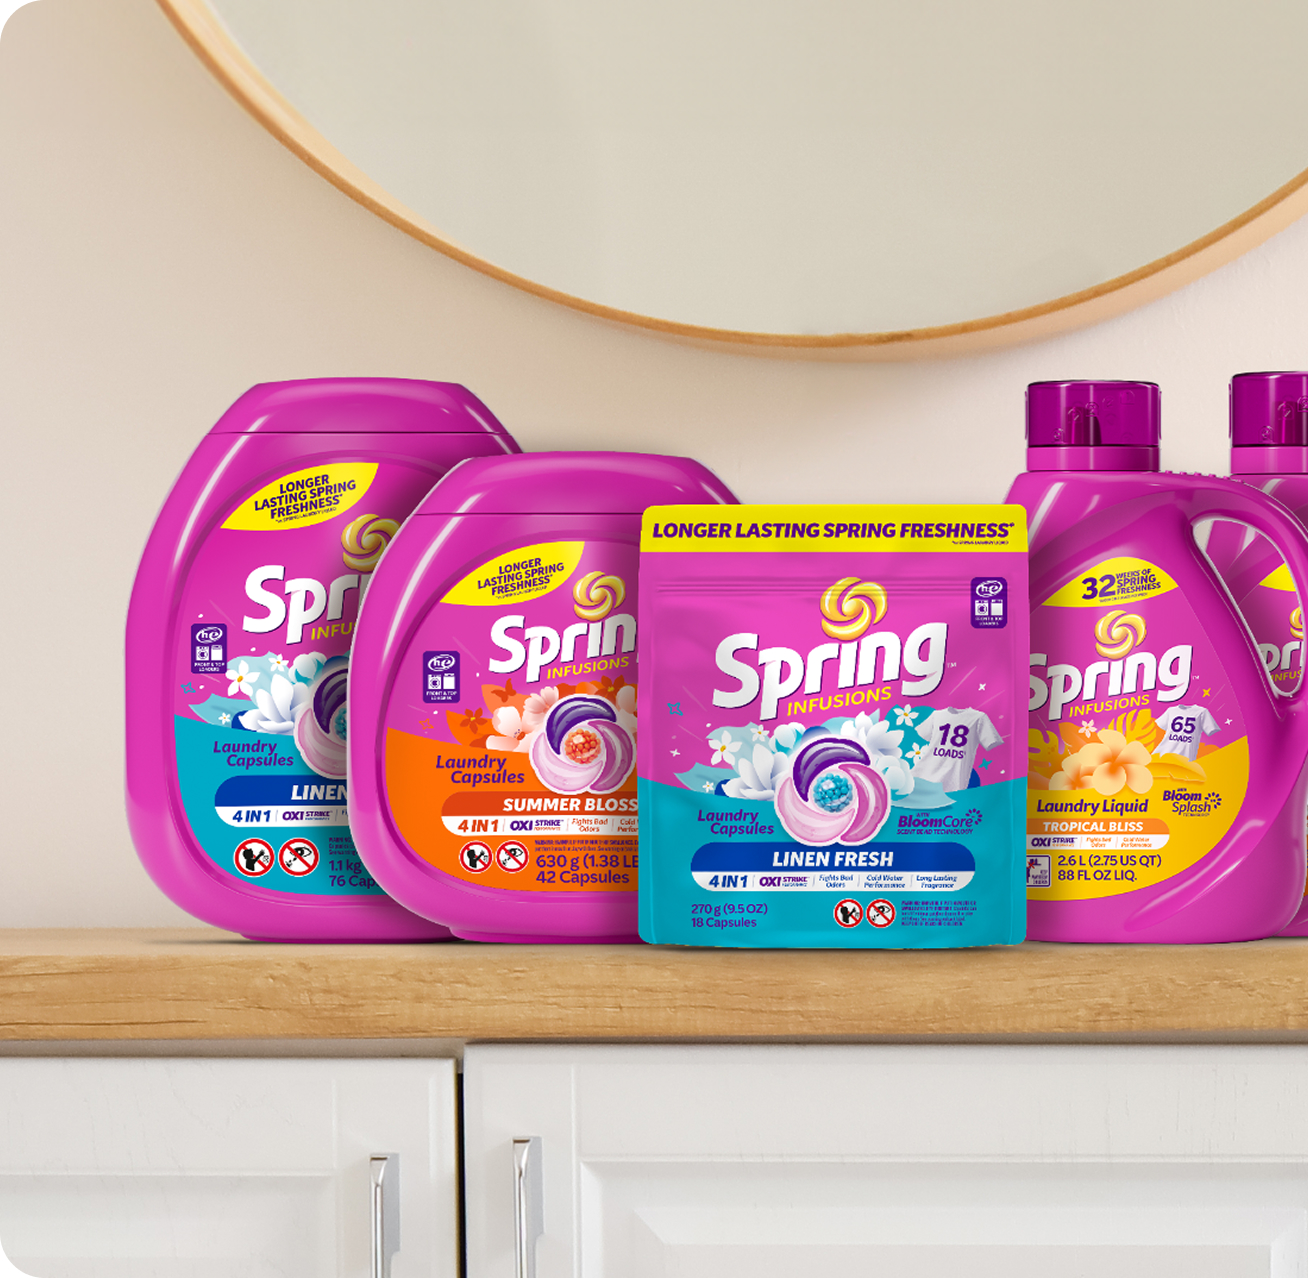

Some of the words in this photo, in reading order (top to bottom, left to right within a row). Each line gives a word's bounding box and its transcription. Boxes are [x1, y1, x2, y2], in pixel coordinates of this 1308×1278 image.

[280, 474, 329, 494] LONGER
[255, 490, 307, 511] LASTING
[309, 479, 356, 499] SPRING
[652, 522, 732, 539] LONGER
[735, 522, 820, 539] LASTING
[823, 522, 896, 539] SPRING
[499, 558, 541, 575] LONGER
[478, 571, 522, 589] LASTING
[524, 562, 564, 577] SPRING
[1116, 570, 1140, 579] WEEKS
[1117, 574, 1156, 588] SPRING
[1081, 574, 1116, 600] 32
[1117, 581, 1161, 595] FRESHNESS
[489, 613, 638, 684] Sprin
[547, 656, 630, 680] INFUSIONS
[712, 622, 949, 722] Spring
[787, 686, 892, 716] INFUSIONS
[1069, 694, 1150, 718] INFUSIONS
[1171, 716, 1196, 734] 65
[939, 723, 969, 747] 18
[213, 739, 277, 756] Laundry
[227, 753, 294, 770] Capsules
[436, 754, 507, 771] Laundry
[451, 769, 525, 787] Capsules
[291, 785, 347, 800] LINEN
[1163, 789, 1202, 801] Bloom
[503, 798, 581, 812] SUMMER
[1036, 799, 1100, 816] Laundry
[1102, 799, 1149, 816] Liquid
[1172, 801, 1211, 815] Splash
[232, 810, 243, 823] 4
[245, 810, 262, 823] IN
[263, 810, 271, 823] 1
[282, 811, 304, 821] OXI
[571, 818, 593, 826] Fights
[697, 809, 759, 824] Laundry
[898, 814, 973, 828] BloomCore
[458, 819, 469, 832] 4
[471, 819, 487, 832] IN
[490, 819, 499, 832] 1
[510, 820, 533, 831] OXI
[535, 819, 561, 827] STRIKE
[710, 822, 774, 838] Capsules
[1043, 822, 1106, 832] TROPICAL
[1108, 822, 1144, 832] BLISS
[1031, 837, 1051, 847] OXI
[329, 860, 343, 871] 1.1
[346, 859, 362, 874] kg
[536, 854, 567, 868] 630
[570, 856, 580, 872] g
[583, 853, 620, 869] (1.38
[772, 851, 830, 867] LINEN
[834, 851, 894, 867] FRESH
[1057, 855, 1077, 866] 2.6
[1079, 855, 1086, 866] L
[1088, 854, 1118, 868] (2.75
[1120, 855, 1137, 866] US
[1139, 854, 1162, 868] QT)
[329, 875, 346, 887] 76
[348, 875, 379, 889] Cap
[536, 870, 556, 884] 42
[559, 869, 630, 887] Capsules
[709, 875, 720, 888] 4
[722, 875, 739, 888] IN
[741, 875, 748, 888] 1
[759, 876, 781, 887] OXI
[1057, 870, 1075, 881] 88
[1077, 870, 1091, 881] FL
[1093, 870, 1111, 881] OZ
[1114, 870, 1137, 882] LIQ.
[691, 903, 713, 915] 270
[714, 905, 721, 917] g
[723, 903, 745, 916] (9.5
[746, 903, 768, 916] OZ)
[691, 917, 704, 928] 18
[706, 917, 758, 930] Capsules
